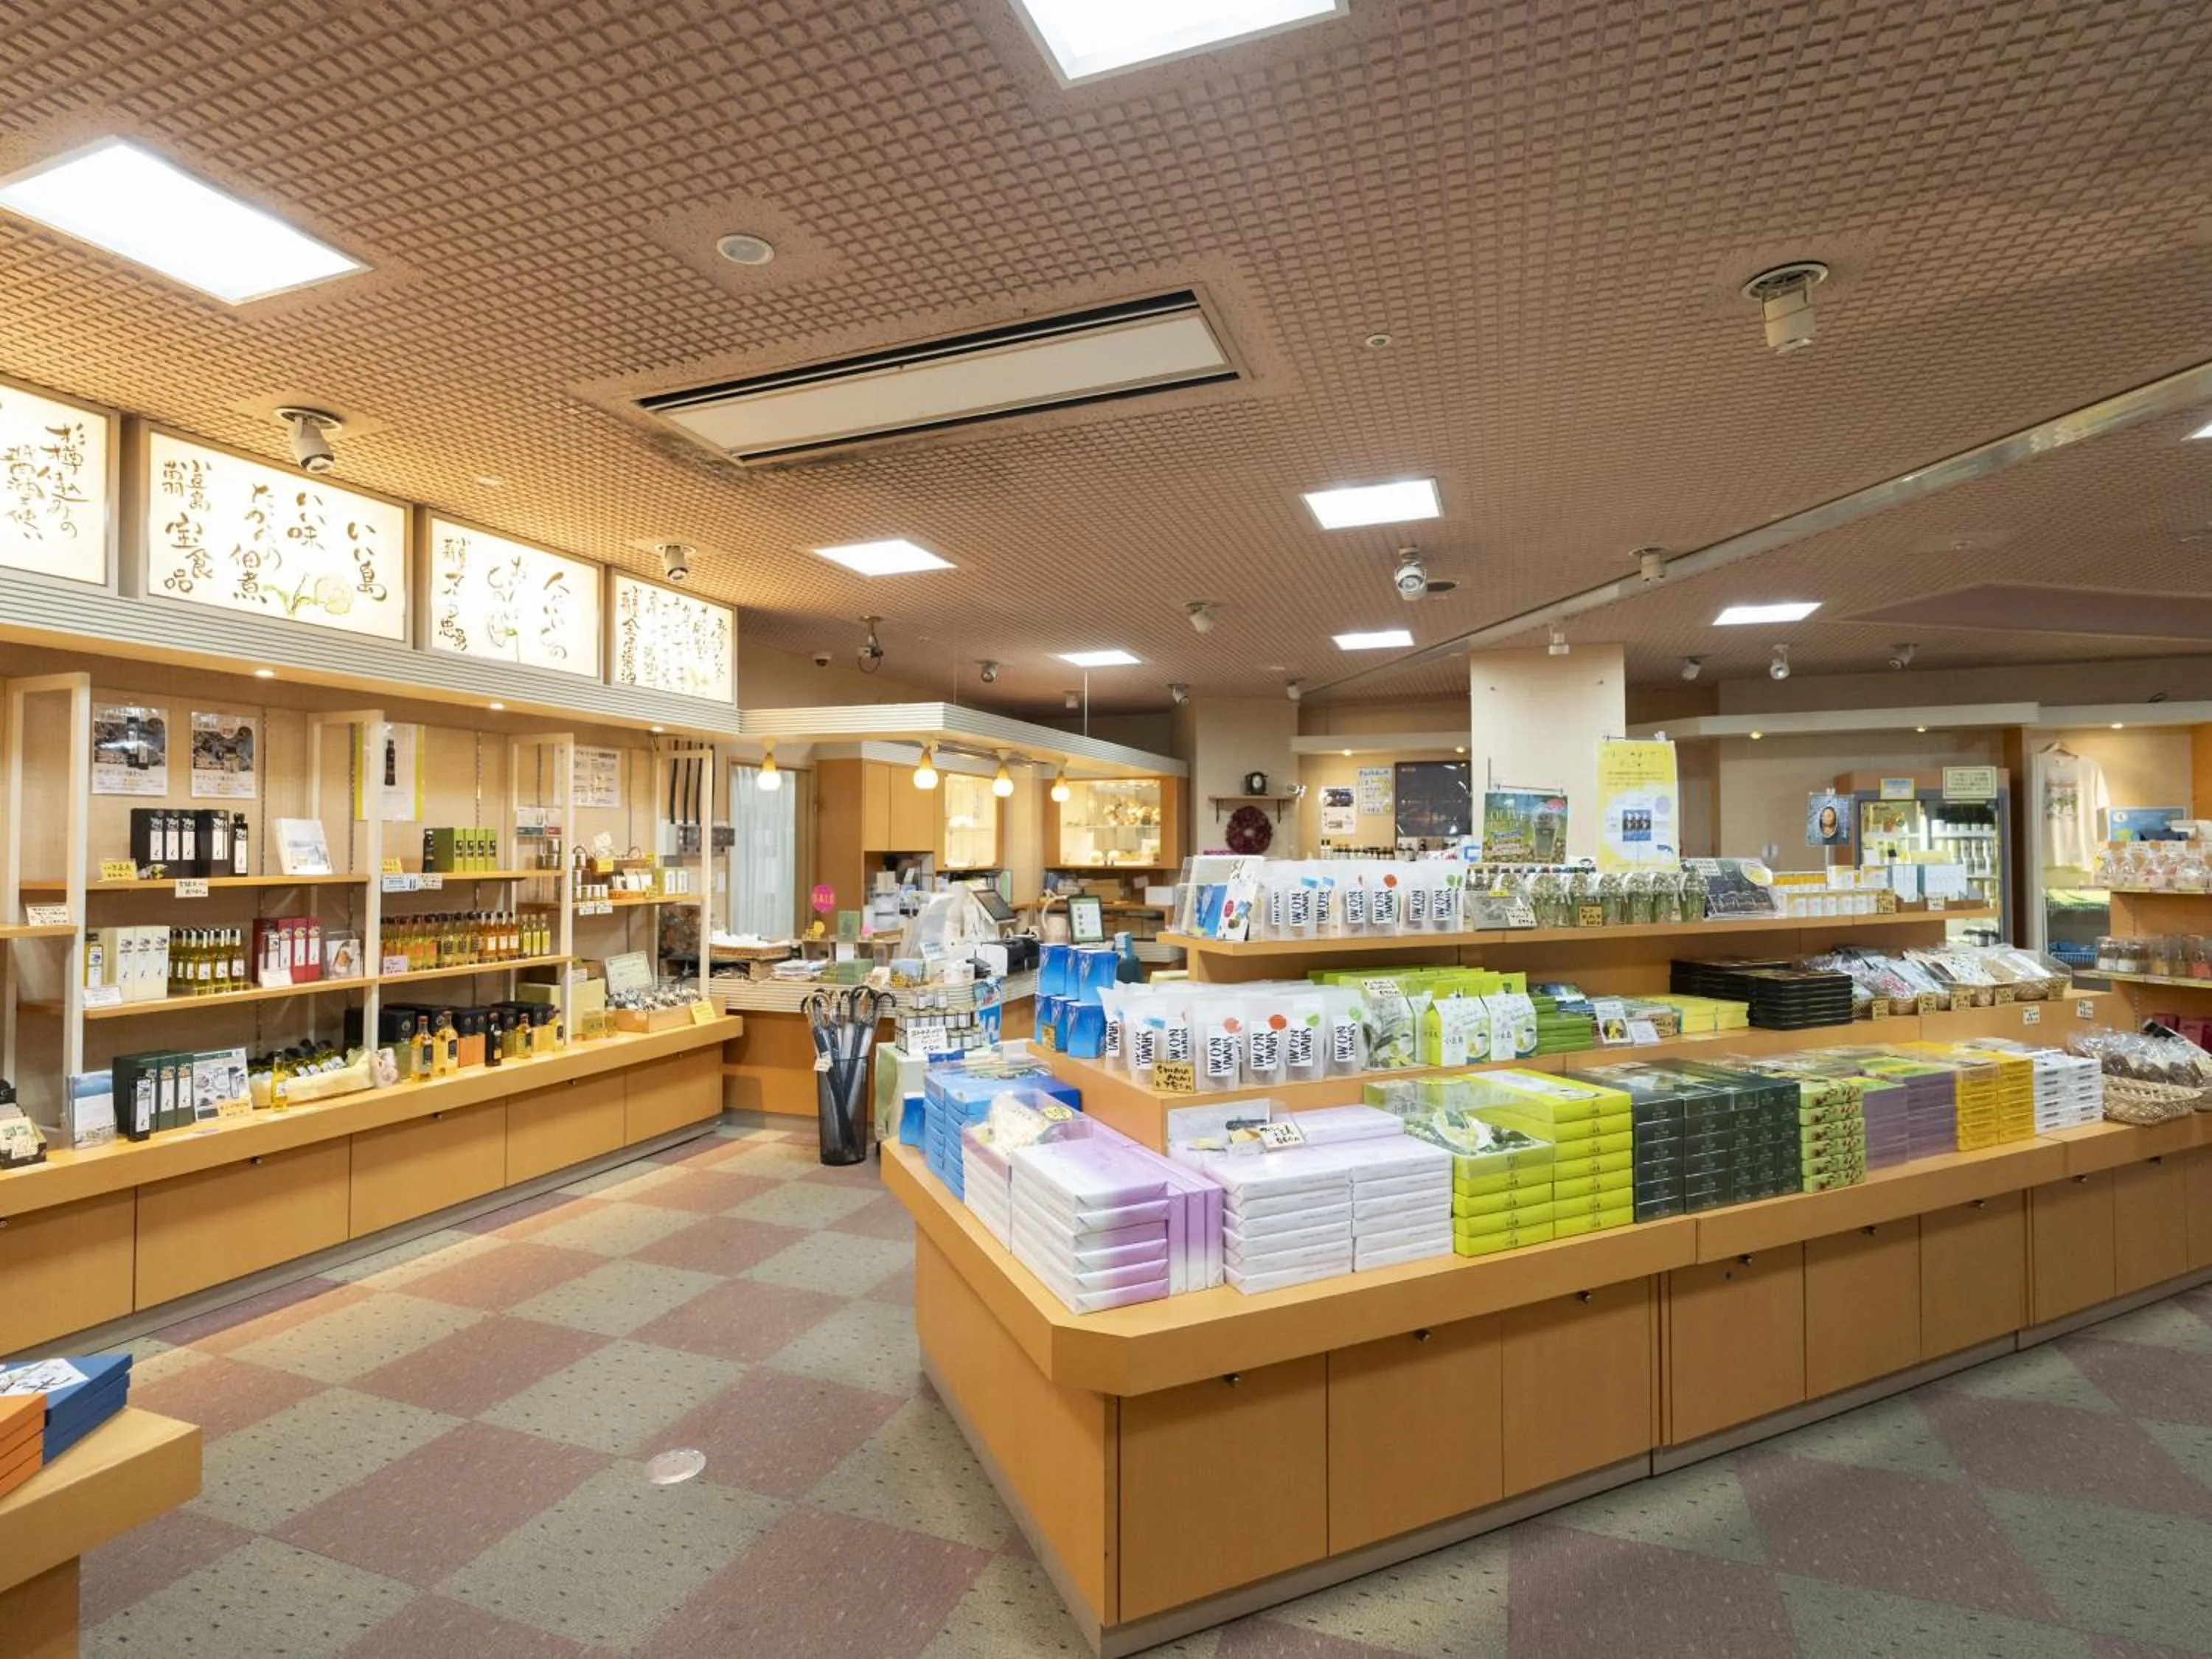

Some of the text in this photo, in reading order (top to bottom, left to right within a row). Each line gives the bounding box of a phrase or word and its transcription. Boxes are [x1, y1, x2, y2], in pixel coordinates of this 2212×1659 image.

[163, 512, 215, 594] 宝食品
[347, 521, 387, 602] いい島
